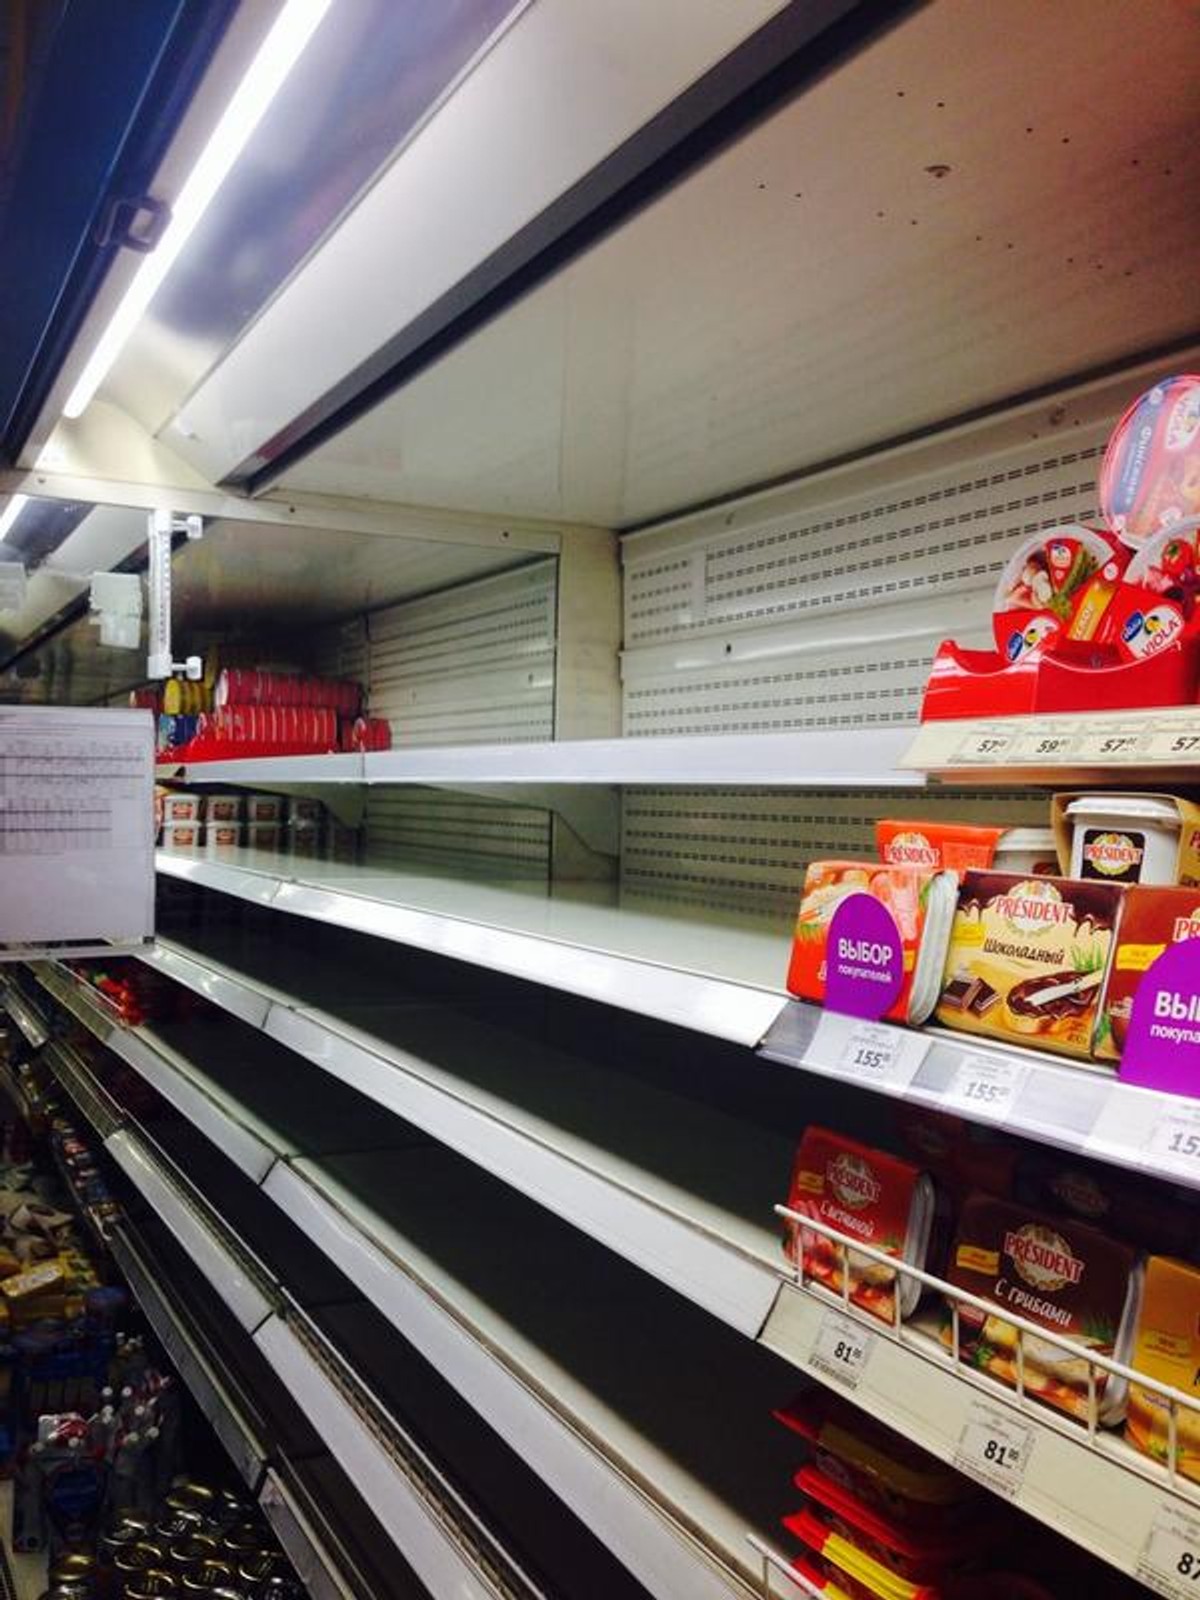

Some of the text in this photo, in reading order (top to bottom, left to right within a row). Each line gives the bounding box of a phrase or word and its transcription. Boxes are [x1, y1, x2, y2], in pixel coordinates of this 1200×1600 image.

[1142, 618, 1179, 657] VIOLA
[838, 938, 893, 966] ВЫБОР
[984, 939, 1065, 965] Шоколадный
[838, 964, 892, 983] покупателей
[1154, 990, 1200, 1023] ВЫ
[1168, 1132, 1200, 1159] 15
[994, 1278, 1073, 1328] С грибами
